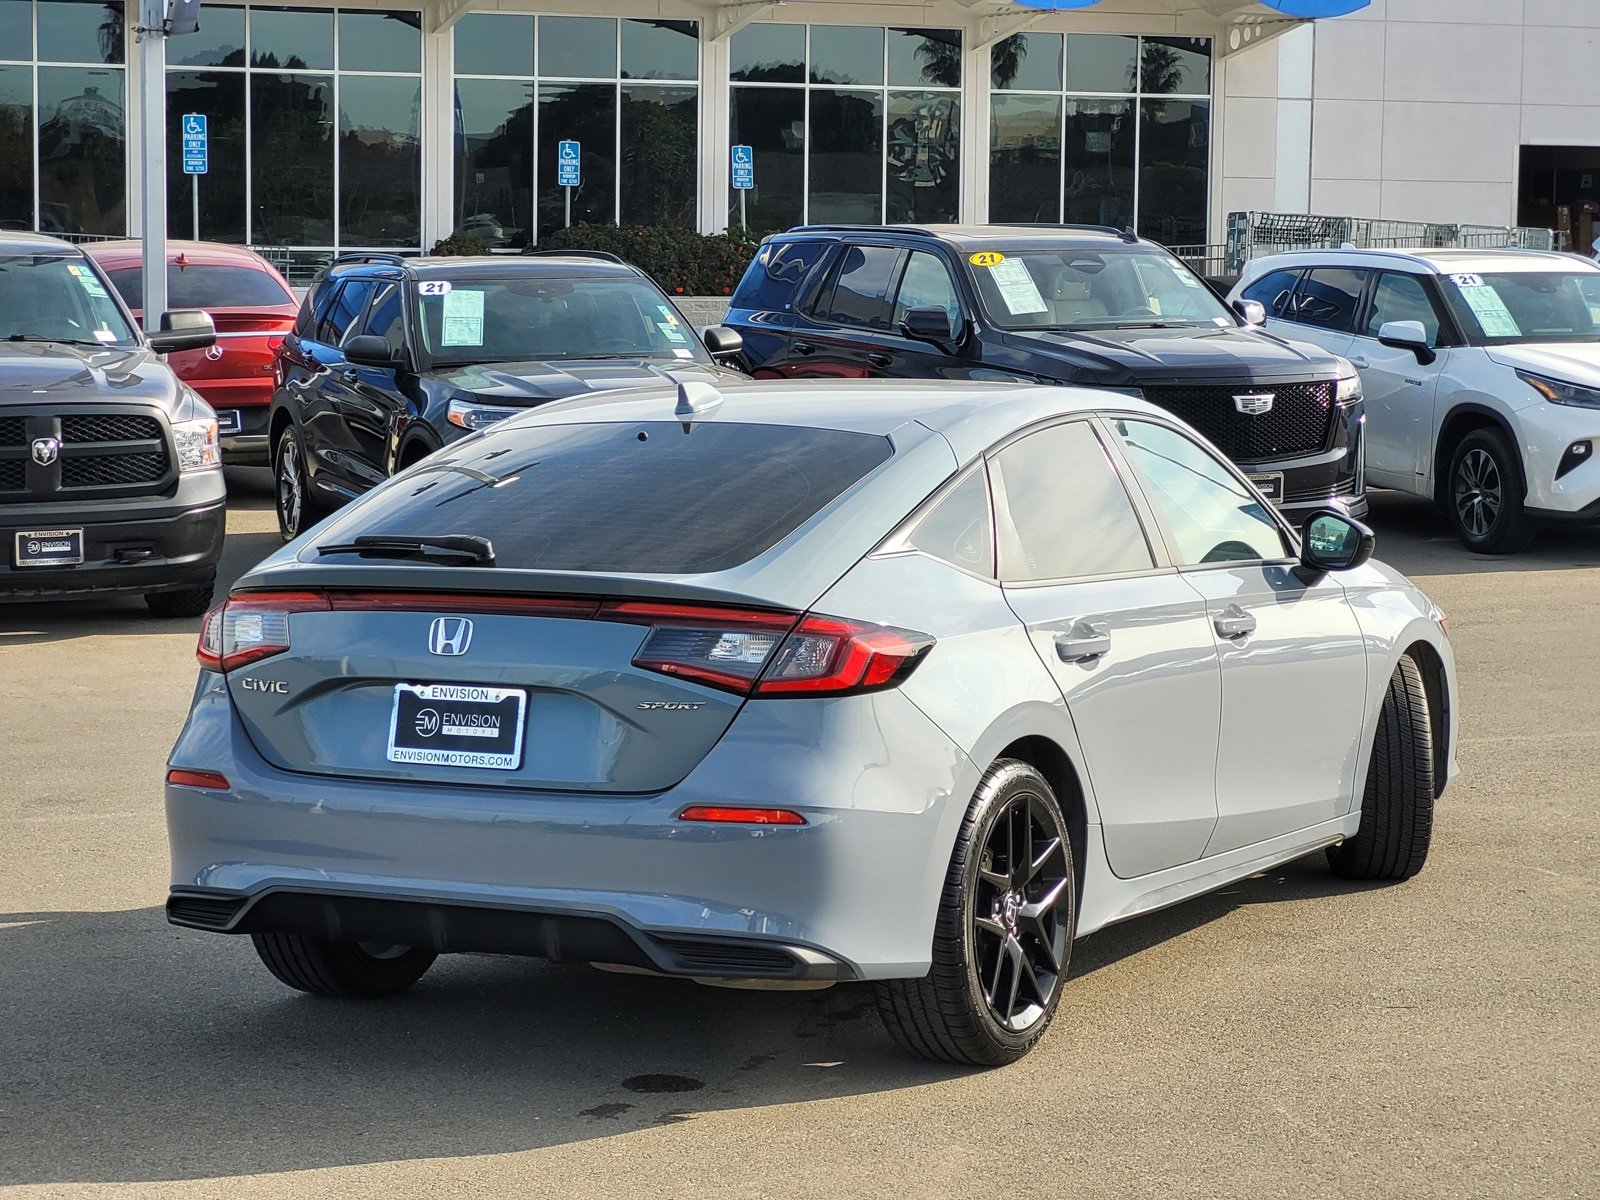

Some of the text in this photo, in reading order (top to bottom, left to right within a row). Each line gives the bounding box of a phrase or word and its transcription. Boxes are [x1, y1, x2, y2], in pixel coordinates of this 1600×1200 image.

[184, 133, 205, 141] PARKING
[979, 254, 995, 264] 21
[1459, 275, 1476, 285] 21
[424, 283, 444, 293] 21
[431, 687, 489, 701] ENVISION
[637, 701, 707, 710] SPORT
[442, 713, 501, 728] ENVISION
[446, 727, 495, 736] MOTORS
[393, 750, 513, 767] ENVISIONMOTORS.COM
